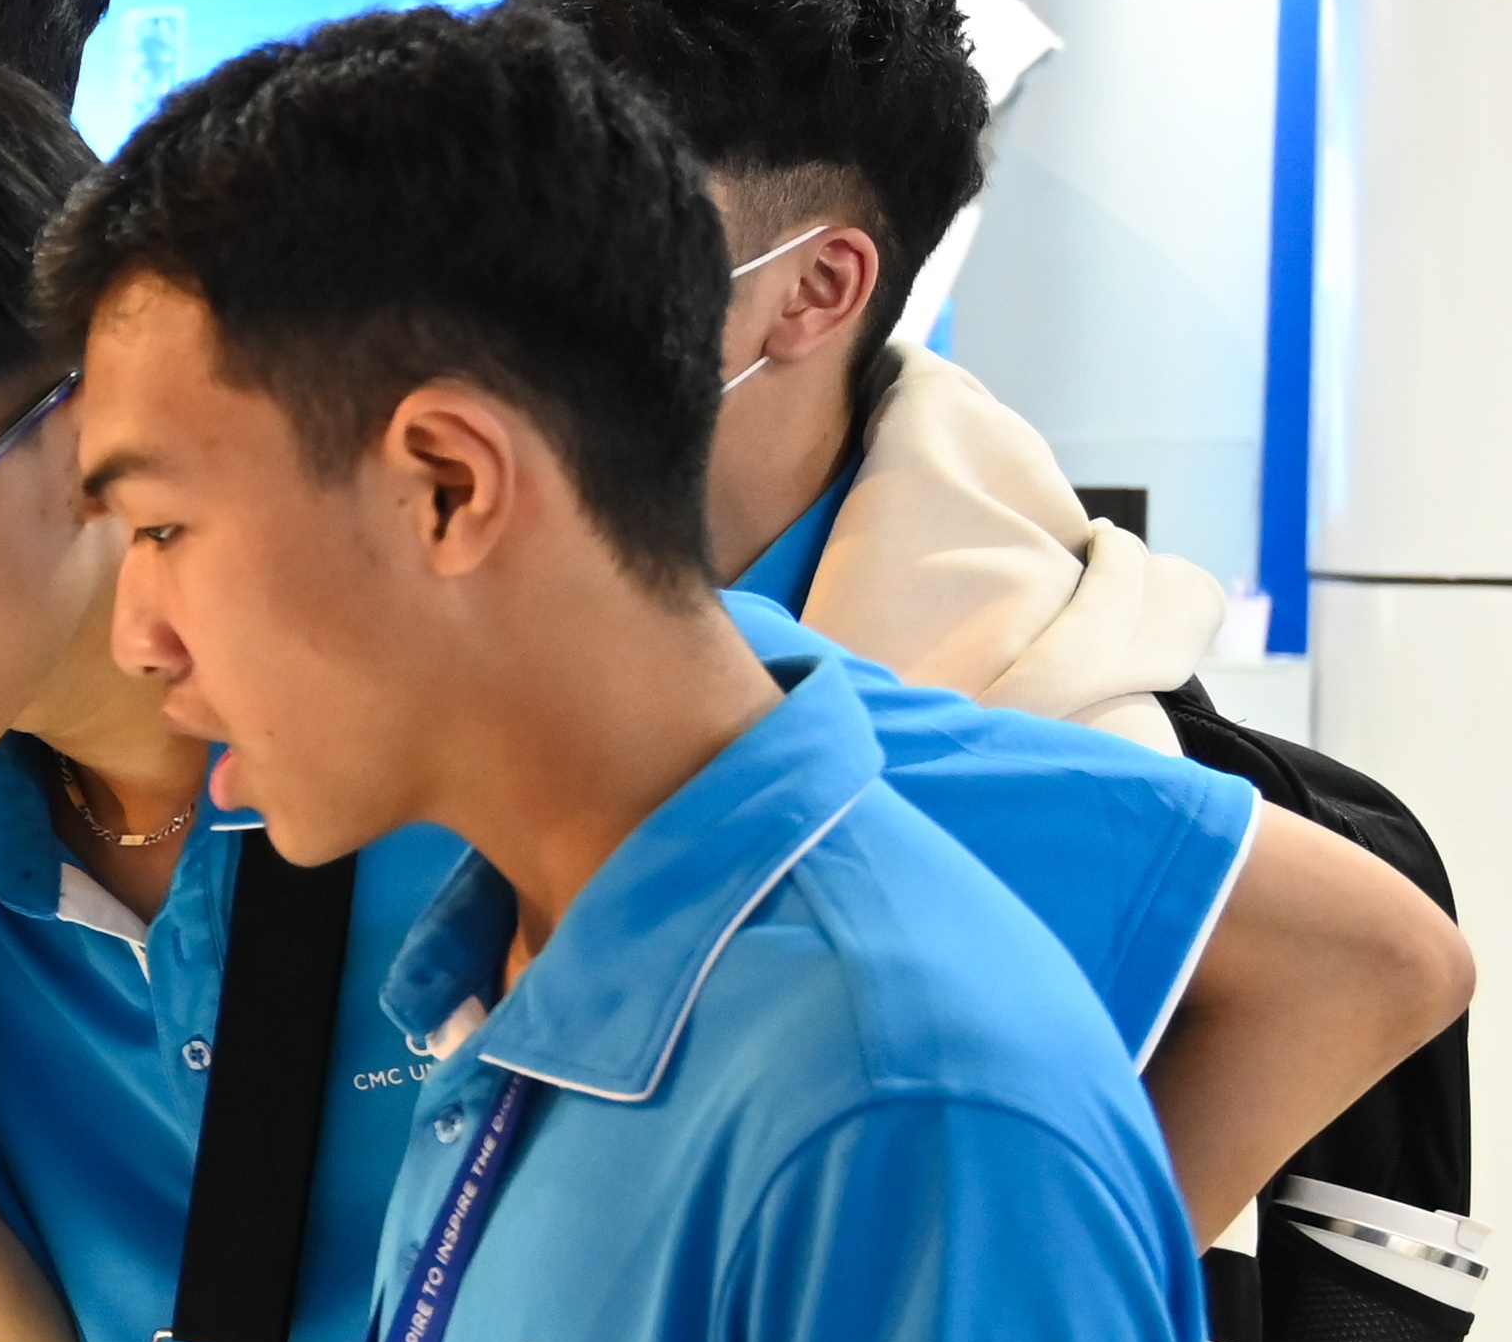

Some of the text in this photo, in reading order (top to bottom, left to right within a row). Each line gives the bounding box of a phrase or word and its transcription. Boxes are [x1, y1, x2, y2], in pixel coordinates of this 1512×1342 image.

[353, 1067, 404, 1091] CMC
[470, 1133, 498, 1177] THE
[433, 1179, 479, 1266] INSPIRE
[422, 1265, 445, 1299] TO
